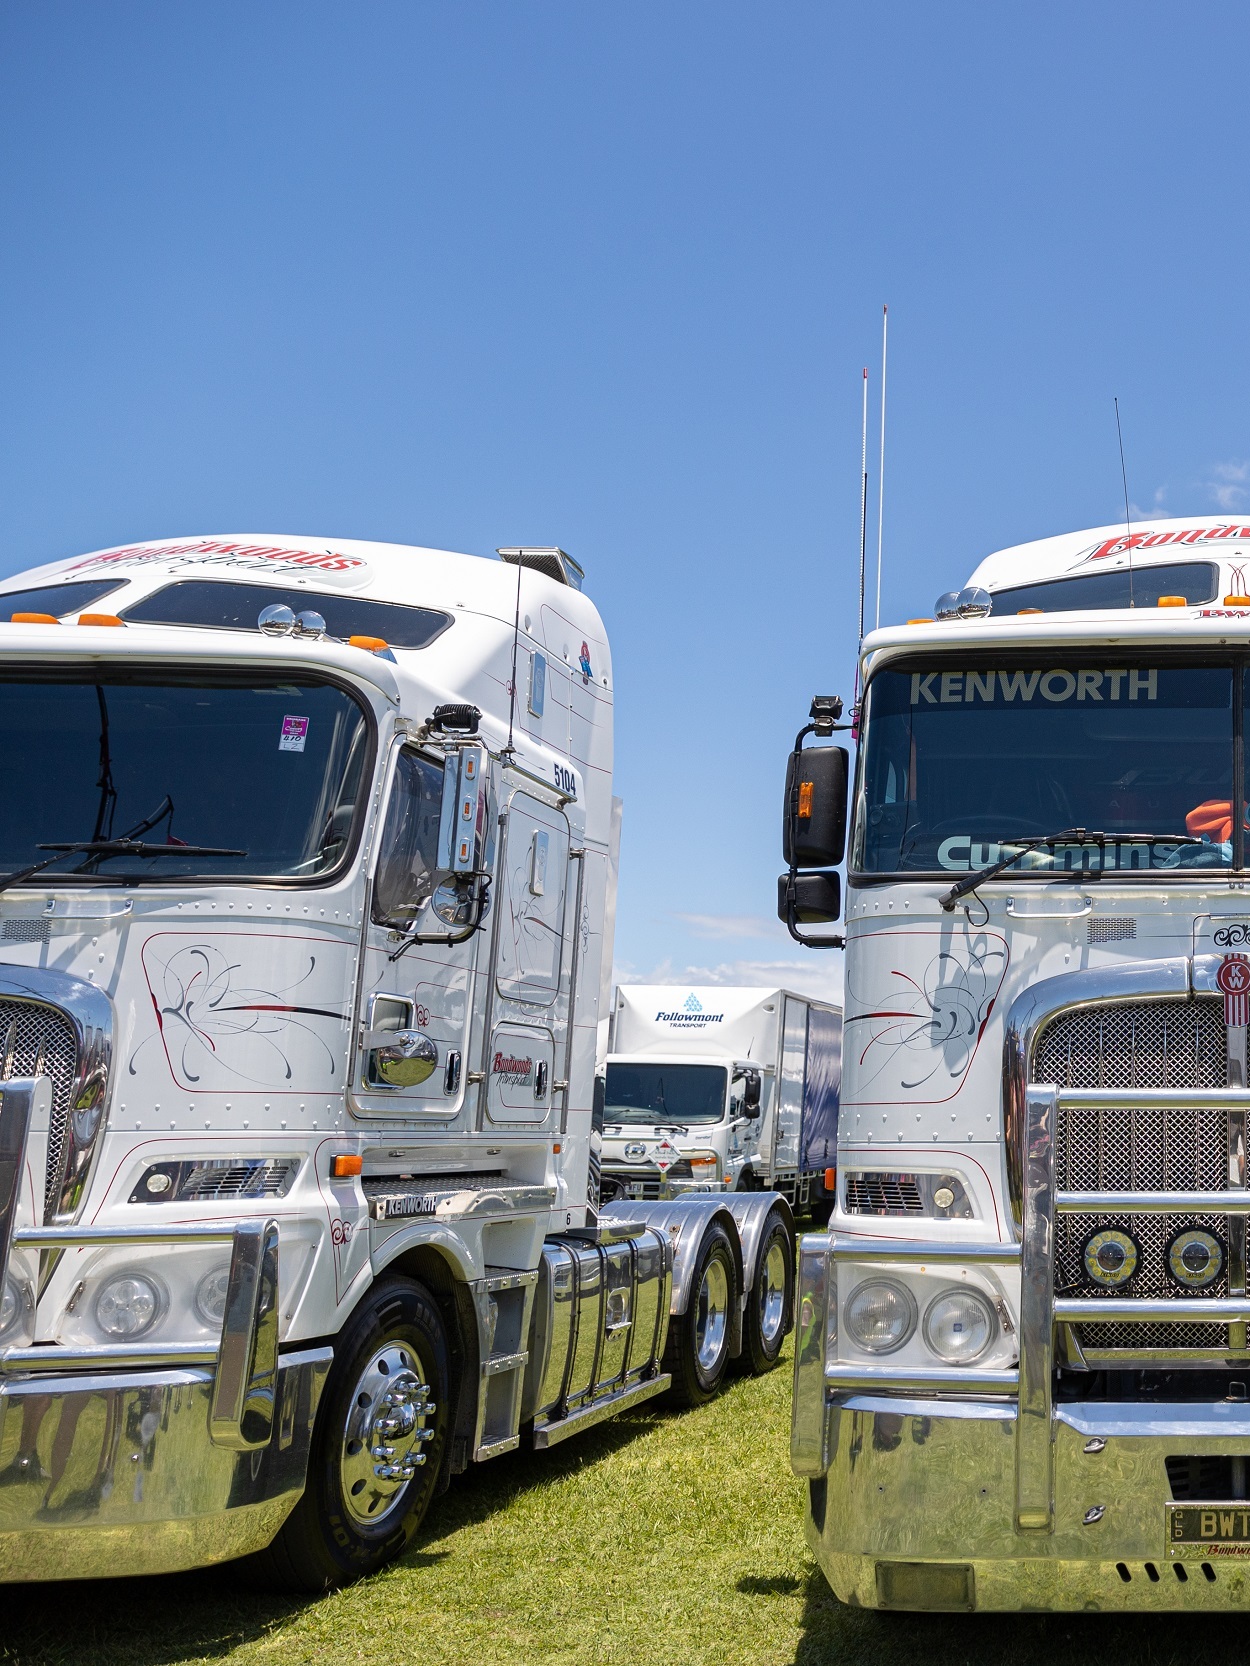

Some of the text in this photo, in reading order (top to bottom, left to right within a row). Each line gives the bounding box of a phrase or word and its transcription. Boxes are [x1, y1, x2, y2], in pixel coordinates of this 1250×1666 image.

[910, 669, 1158, 705] KENWORTH
[553, 763, 576, 795] 5104
[655, 1012, 724, 1022] Followmont
[388, 1196, 437, 1215] KENWORTH
[1175, 1511, 1184, 1537] QLD
